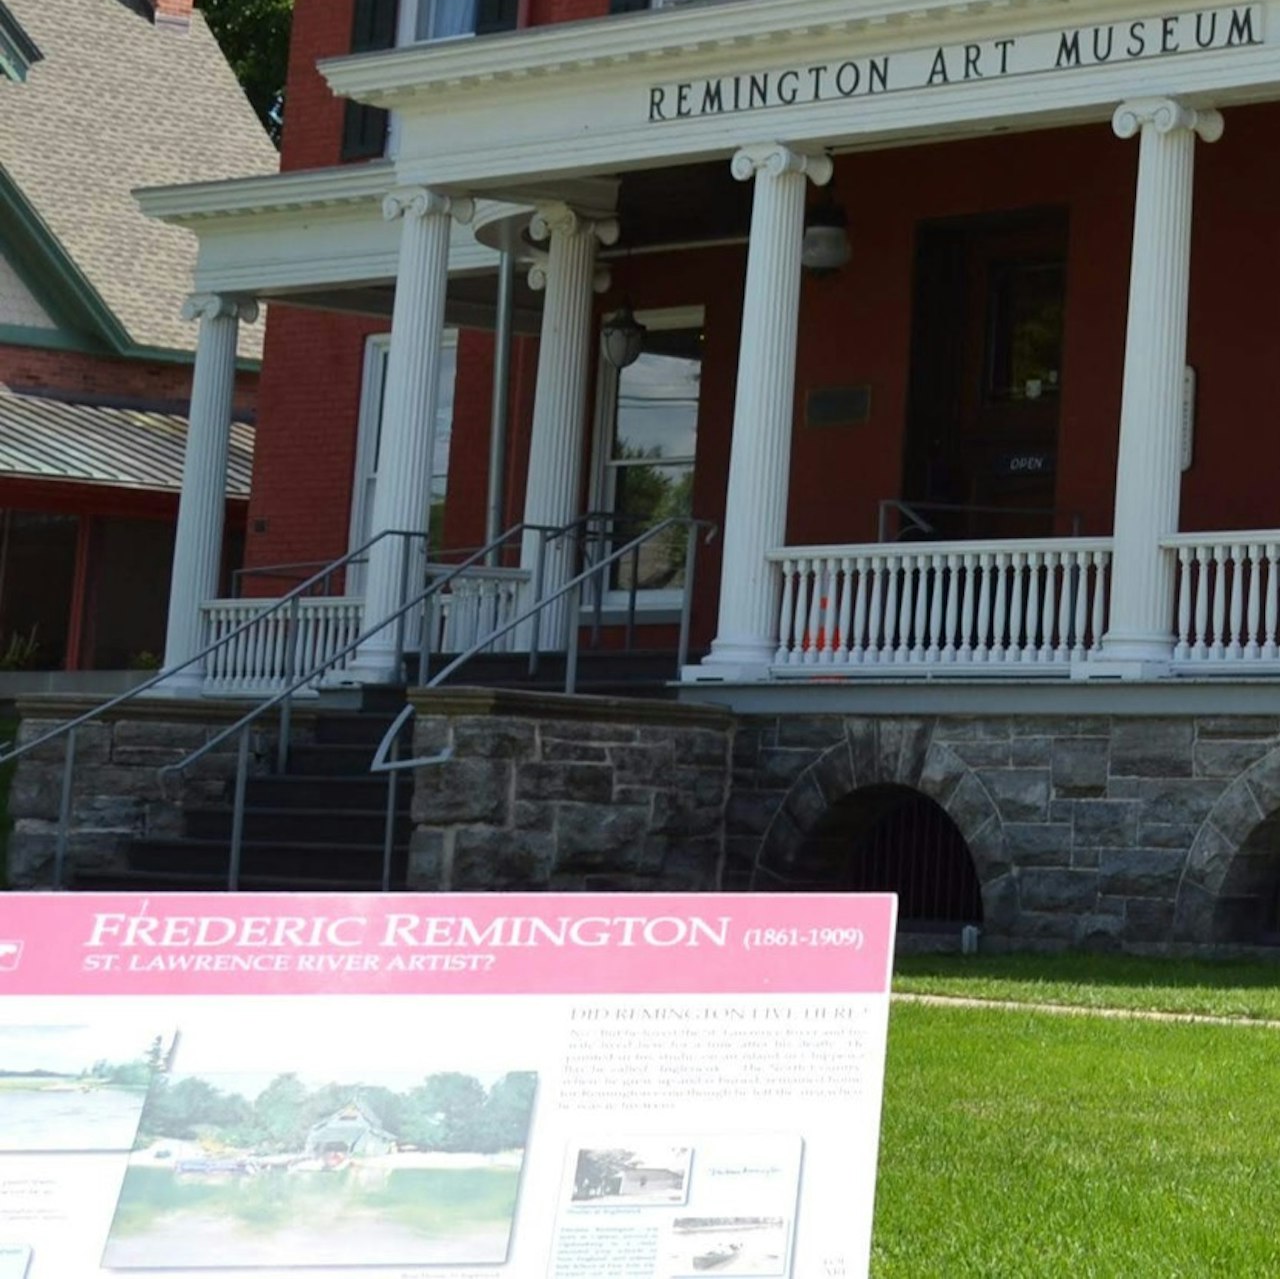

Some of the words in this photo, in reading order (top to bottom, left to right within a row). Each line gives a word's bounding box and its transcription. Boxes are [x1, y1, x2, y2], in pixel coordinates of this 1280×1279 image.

[649, 57, 889, 120] REMINGTON
[926, 40, 1015, 86] ART
[1055, 7, 1256, 69] MUSEUM
[1010, 456, 1043, 470] OPEN
[84, 913, 366, 947] FREDERIC
[379, 913, 731, 947] REMINGTON
[743, 927, 864, 950] (1861-1909)
[84, 954, 120, 971] ST.
[129, 954, 292, 971] LAWRENCE
[296, 954, 379, 971] RIVER
[387, 954, 496, 971] ARTIST?
[615, 1007, 744, 1020] REMINGTON
